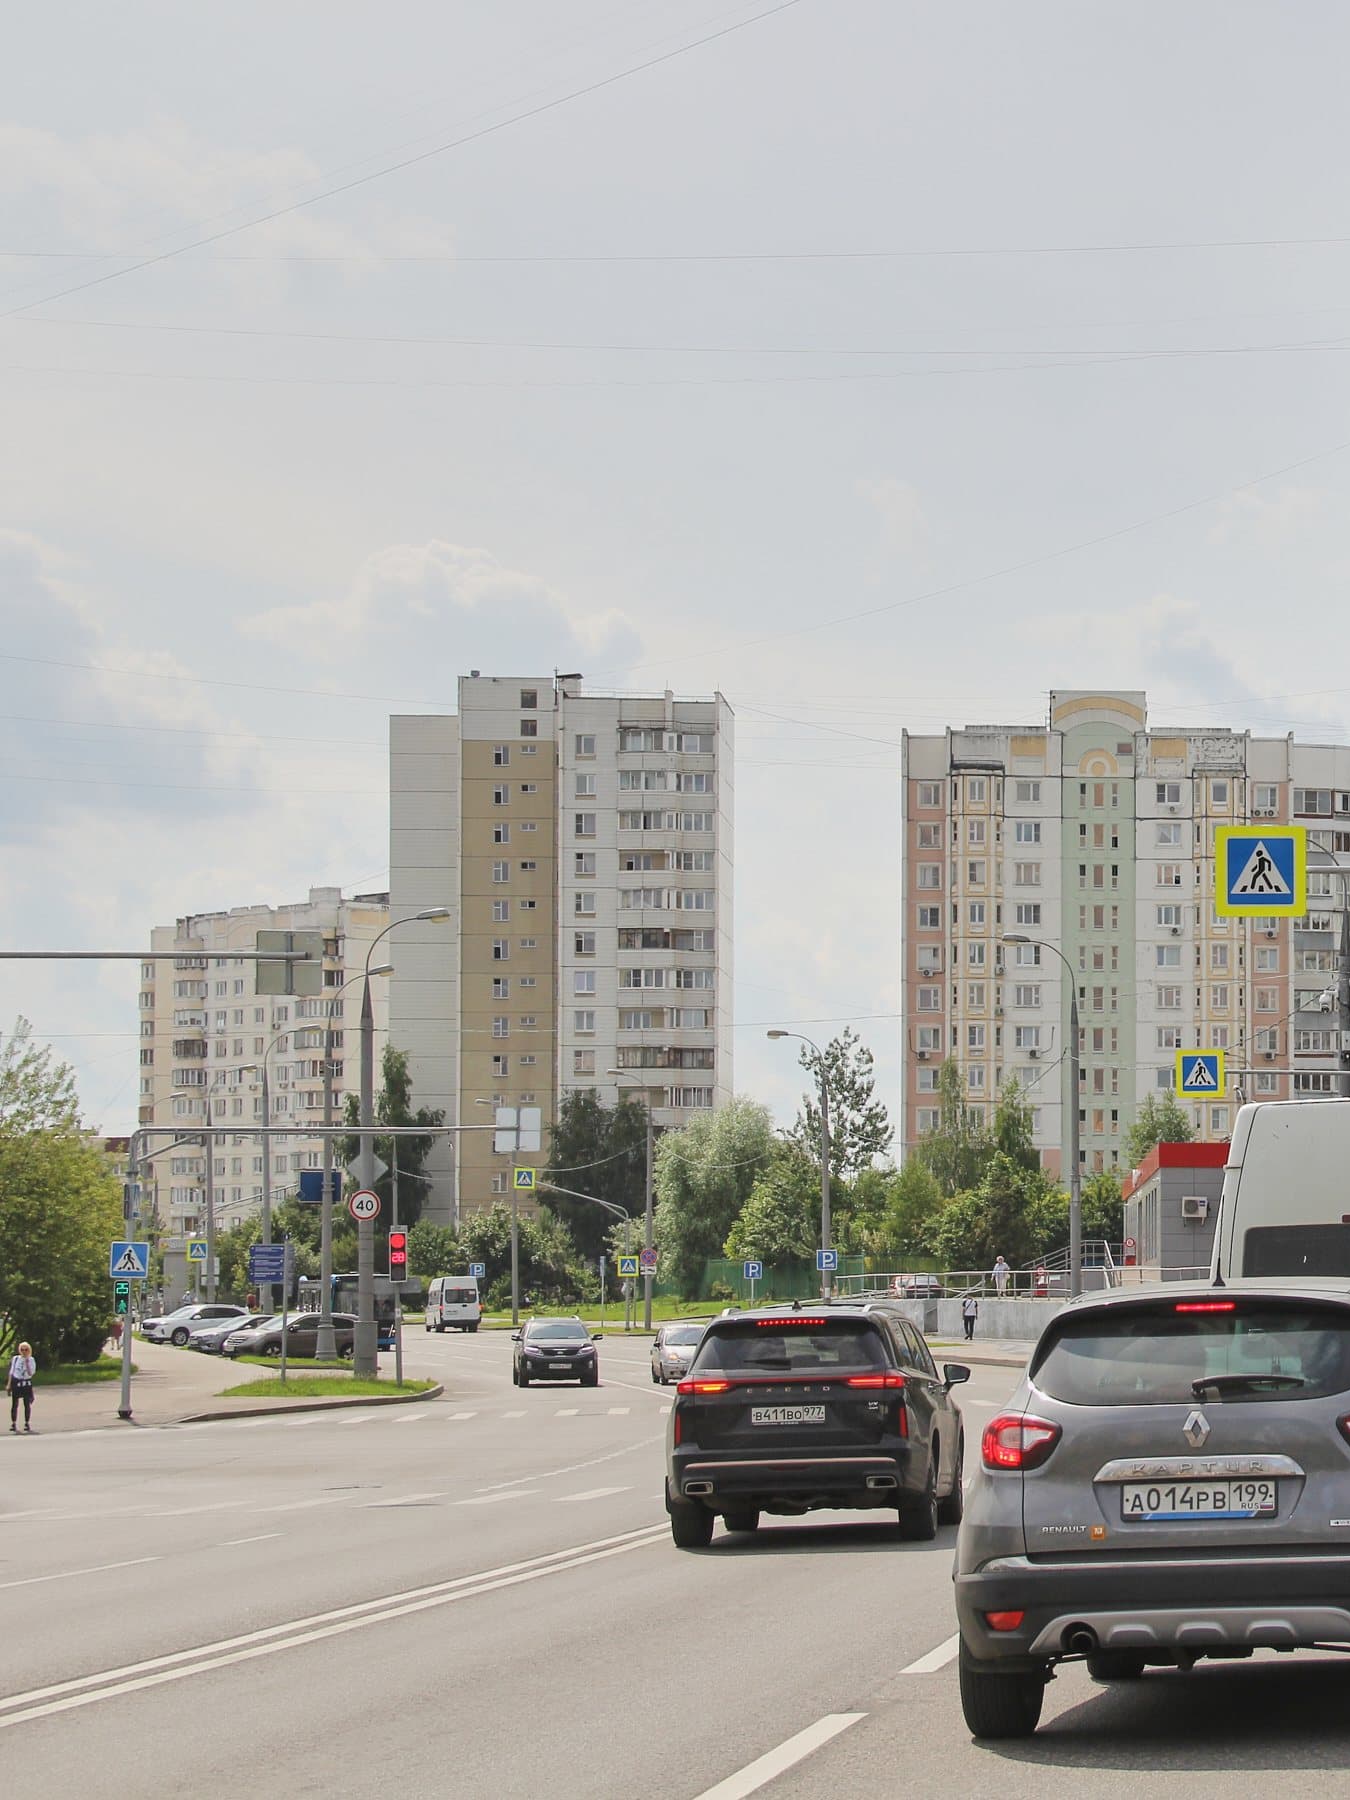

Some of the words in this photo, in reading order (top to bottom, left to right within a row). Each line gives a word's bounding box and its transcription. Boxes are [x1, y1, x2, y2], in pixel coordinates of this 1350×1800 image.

[355, 1199, 374, 1212] 40
[391, 1252, 406, 1263] 28
[822, 1252, 834, 1268] P
[749, 1263, 759, 1277] P
[804, 1406, 823, 1417] 977
[1131, 1461, 1265, 1475] KAPTUR
[1130, 1486, 1227, 1512] А014РВ
[1232, 1483, 1270, 1502] 199
[1240, 1502, 1260, 1510] RUS
[1041, 1525, 1087, 1534] RENAULT
